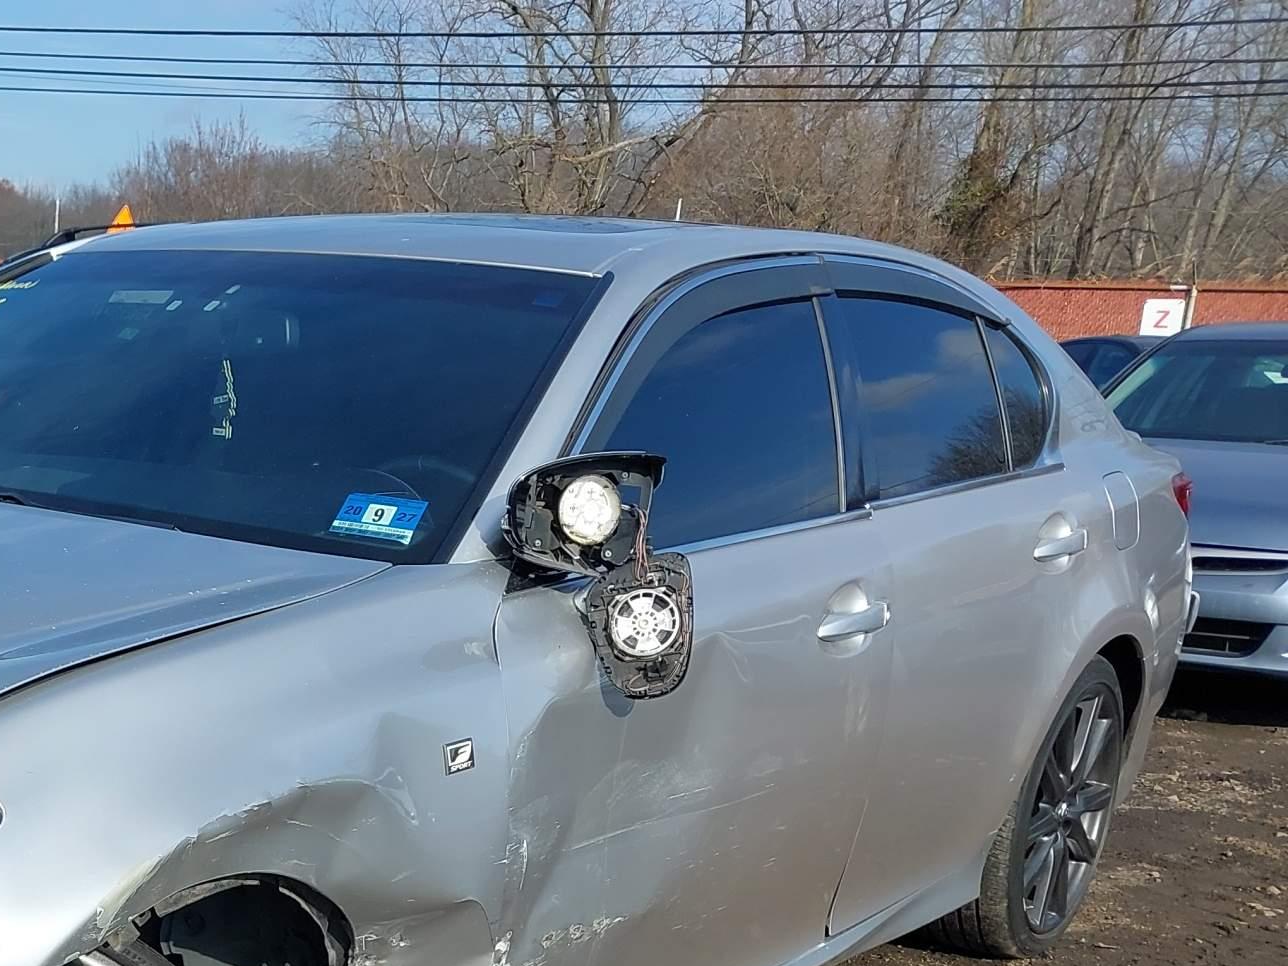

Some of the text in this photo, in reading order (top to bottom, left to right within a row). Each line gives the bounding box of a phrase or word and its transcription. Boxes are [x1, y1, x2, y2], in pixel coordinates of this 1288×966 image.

[1152, 310, 1171, 329] Z
[343, 504, 417, 523] 20 9 27
